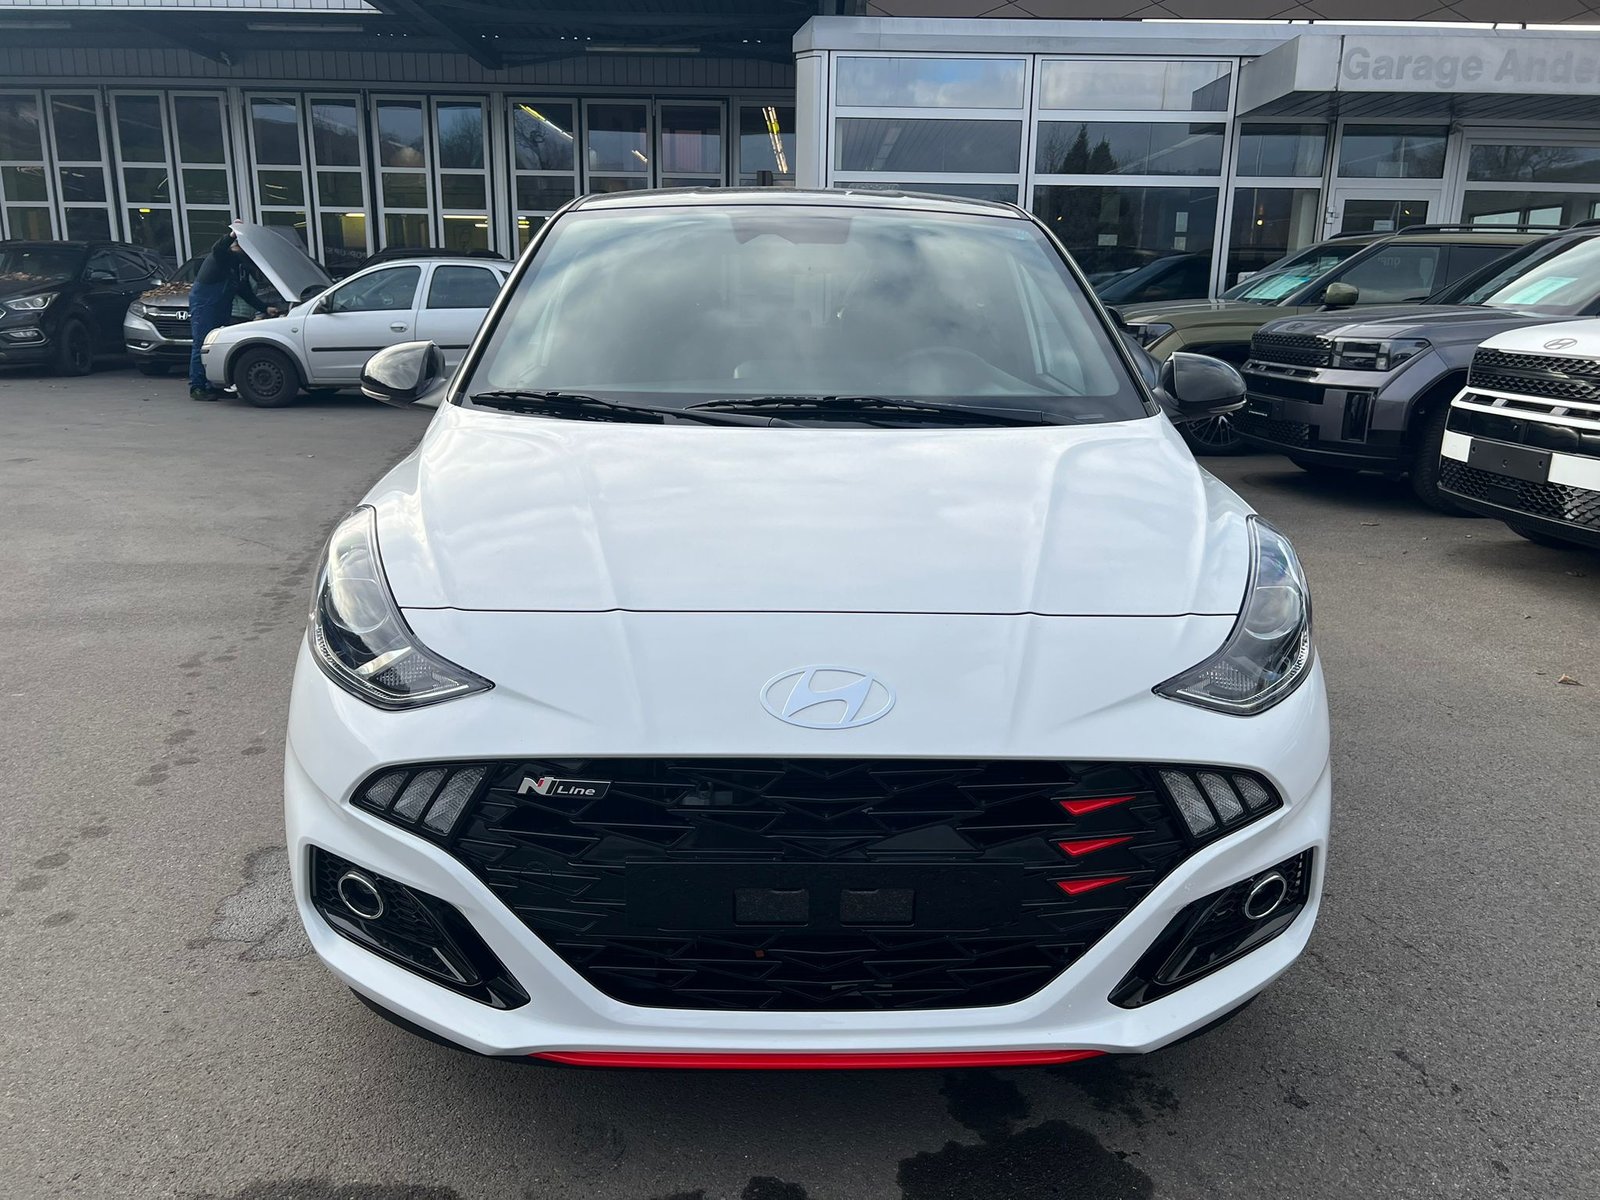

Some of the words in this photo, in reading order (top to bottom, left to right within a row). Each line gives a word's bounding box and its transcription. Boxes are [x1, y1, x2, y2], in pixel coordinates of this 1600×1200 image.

[1342, 46, 1483, 89] Garage
[1494, 48, 1600, 85] Ande
[557, 785, 596, 796] Line
